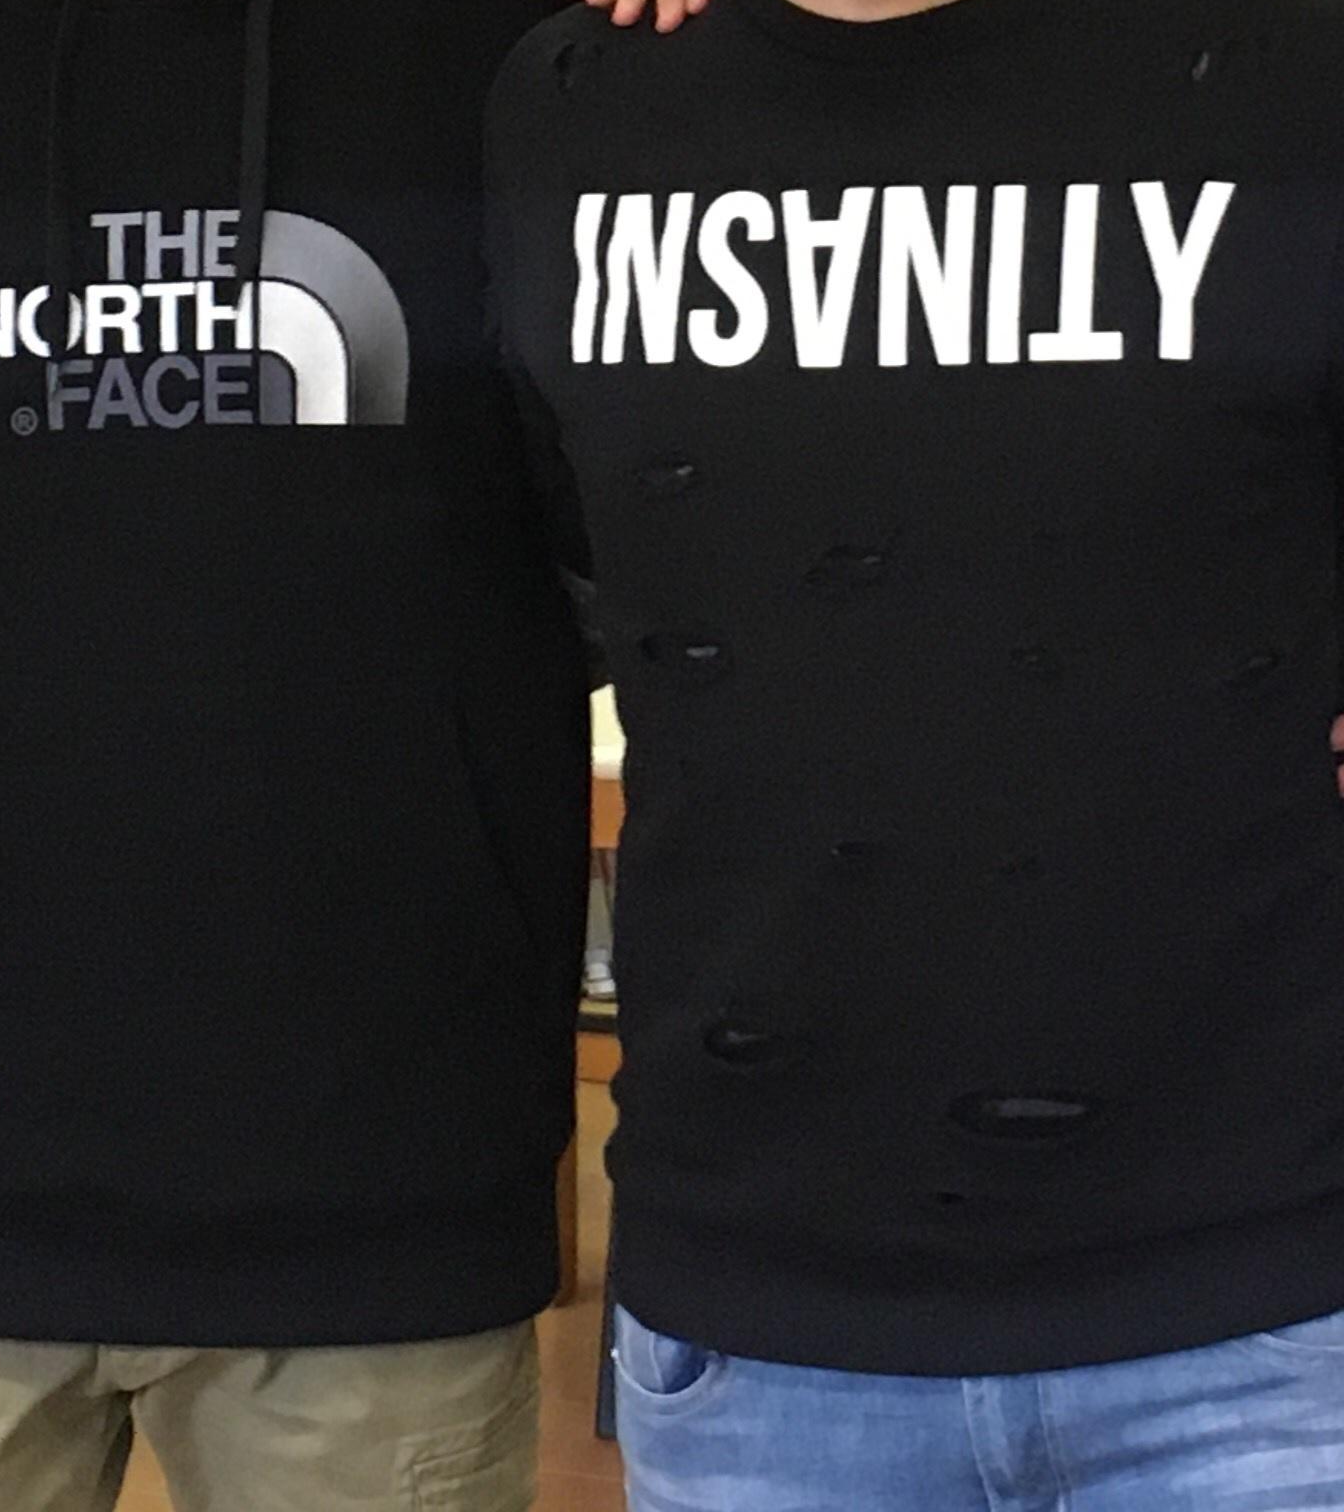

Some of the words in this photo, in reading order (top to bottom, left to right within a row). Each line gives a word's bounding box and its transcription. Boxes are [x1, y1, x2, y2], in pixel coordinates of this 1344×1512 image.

[90, 210, 241, 281] THE
[571, 181, 1237, 368] INSANITY
[46, 354, 254, 430] FACE
